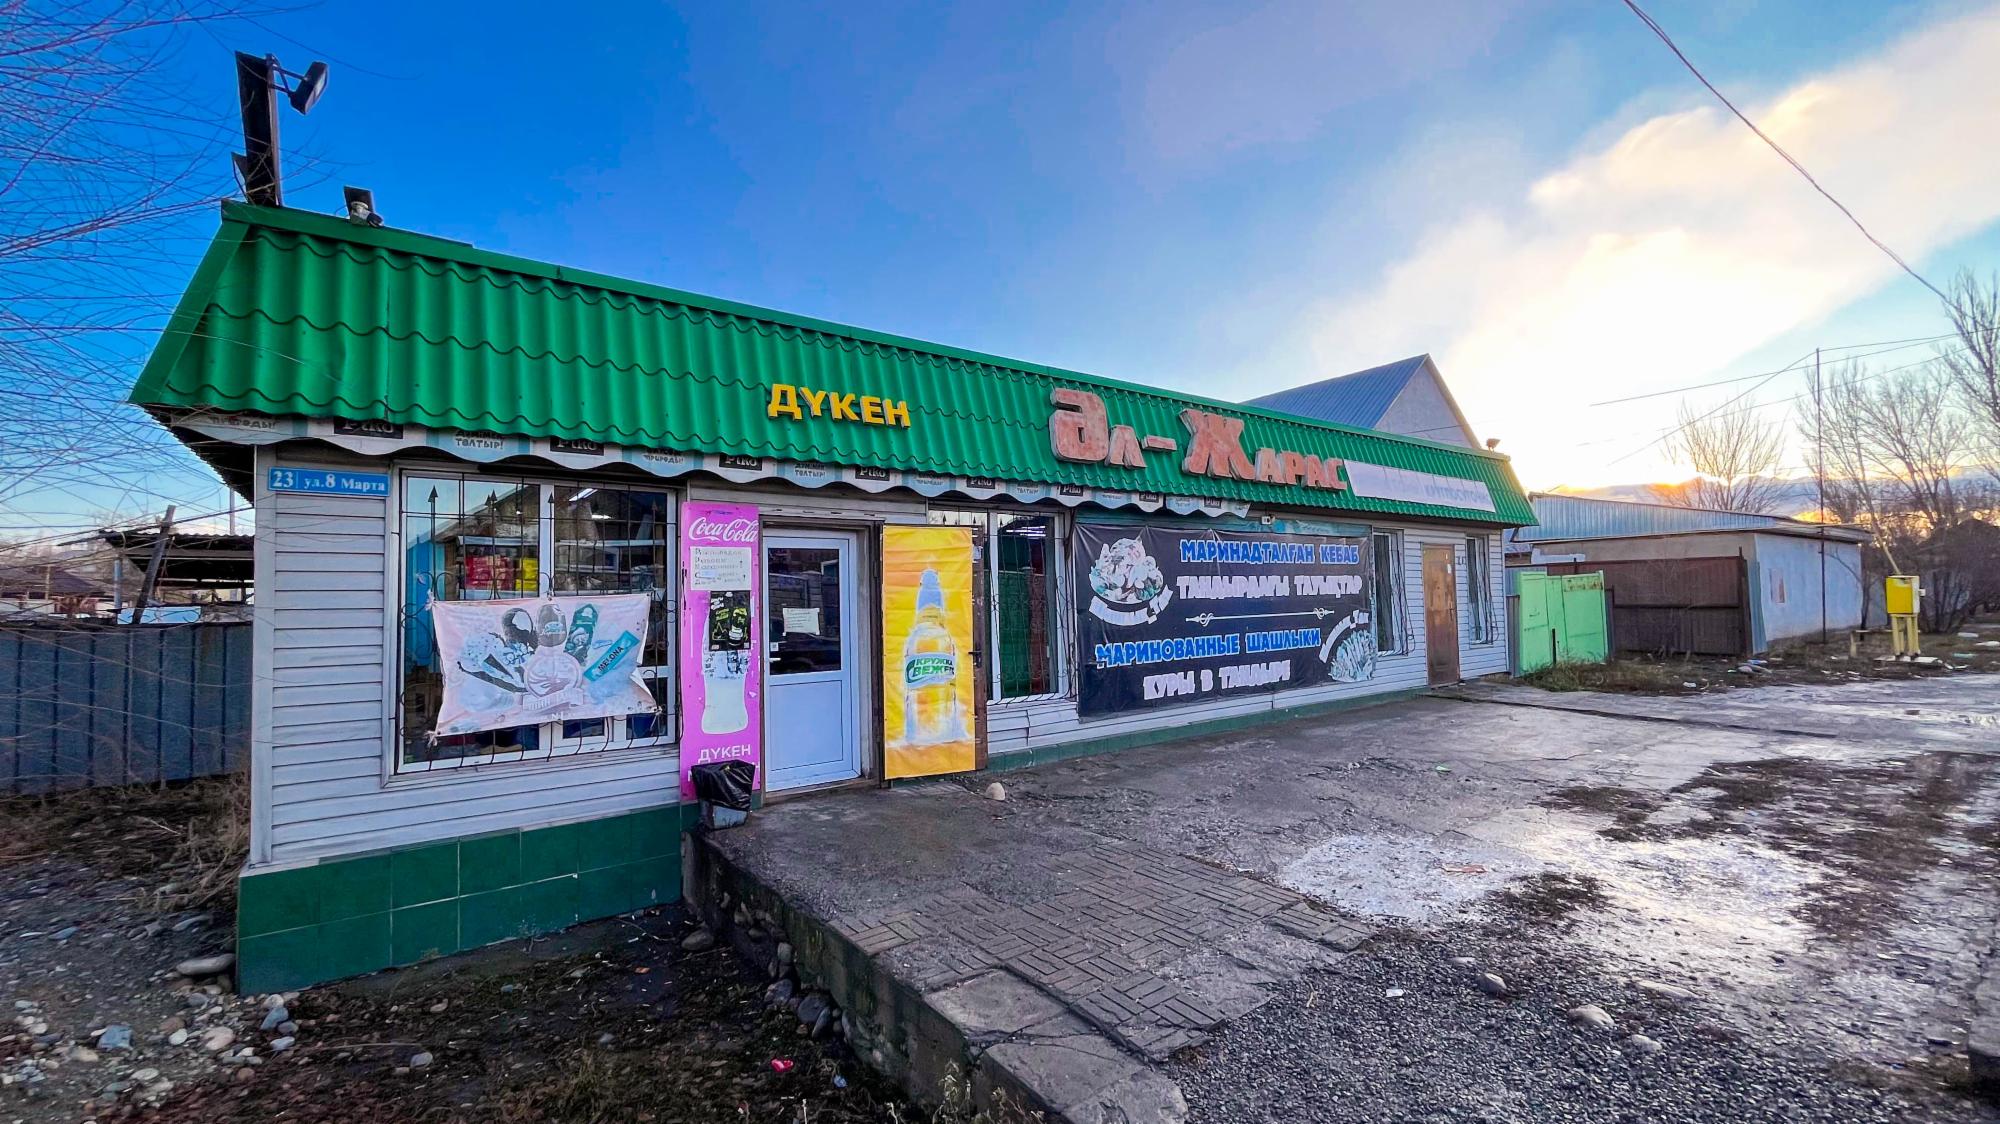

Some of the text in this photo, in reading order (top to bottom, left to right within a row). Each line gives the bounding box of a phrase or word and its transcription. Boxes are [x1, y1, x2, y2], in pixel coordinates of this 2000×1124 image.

[767, 383, 911, 429] ДҮКЕН
[272, 470, 294, 488] 23
[341, 478, 385, 492] Марта
[689, 516, 759, 542] Coca-Cola
[1319, 544, 1360, 565] КЕБАБ
[598, 646, 624, 671] MELONA
[1095, 633, 1240, 669] МАРИНОВАННЫЕ
[1245, 628, 1322, 654] ШАШЛЫКИ
[1143, 671, 1196, 701] КУРЫ
[1201, 669, 1214, 692] В
[698, 744, 751, 764] ДҮКЕН
